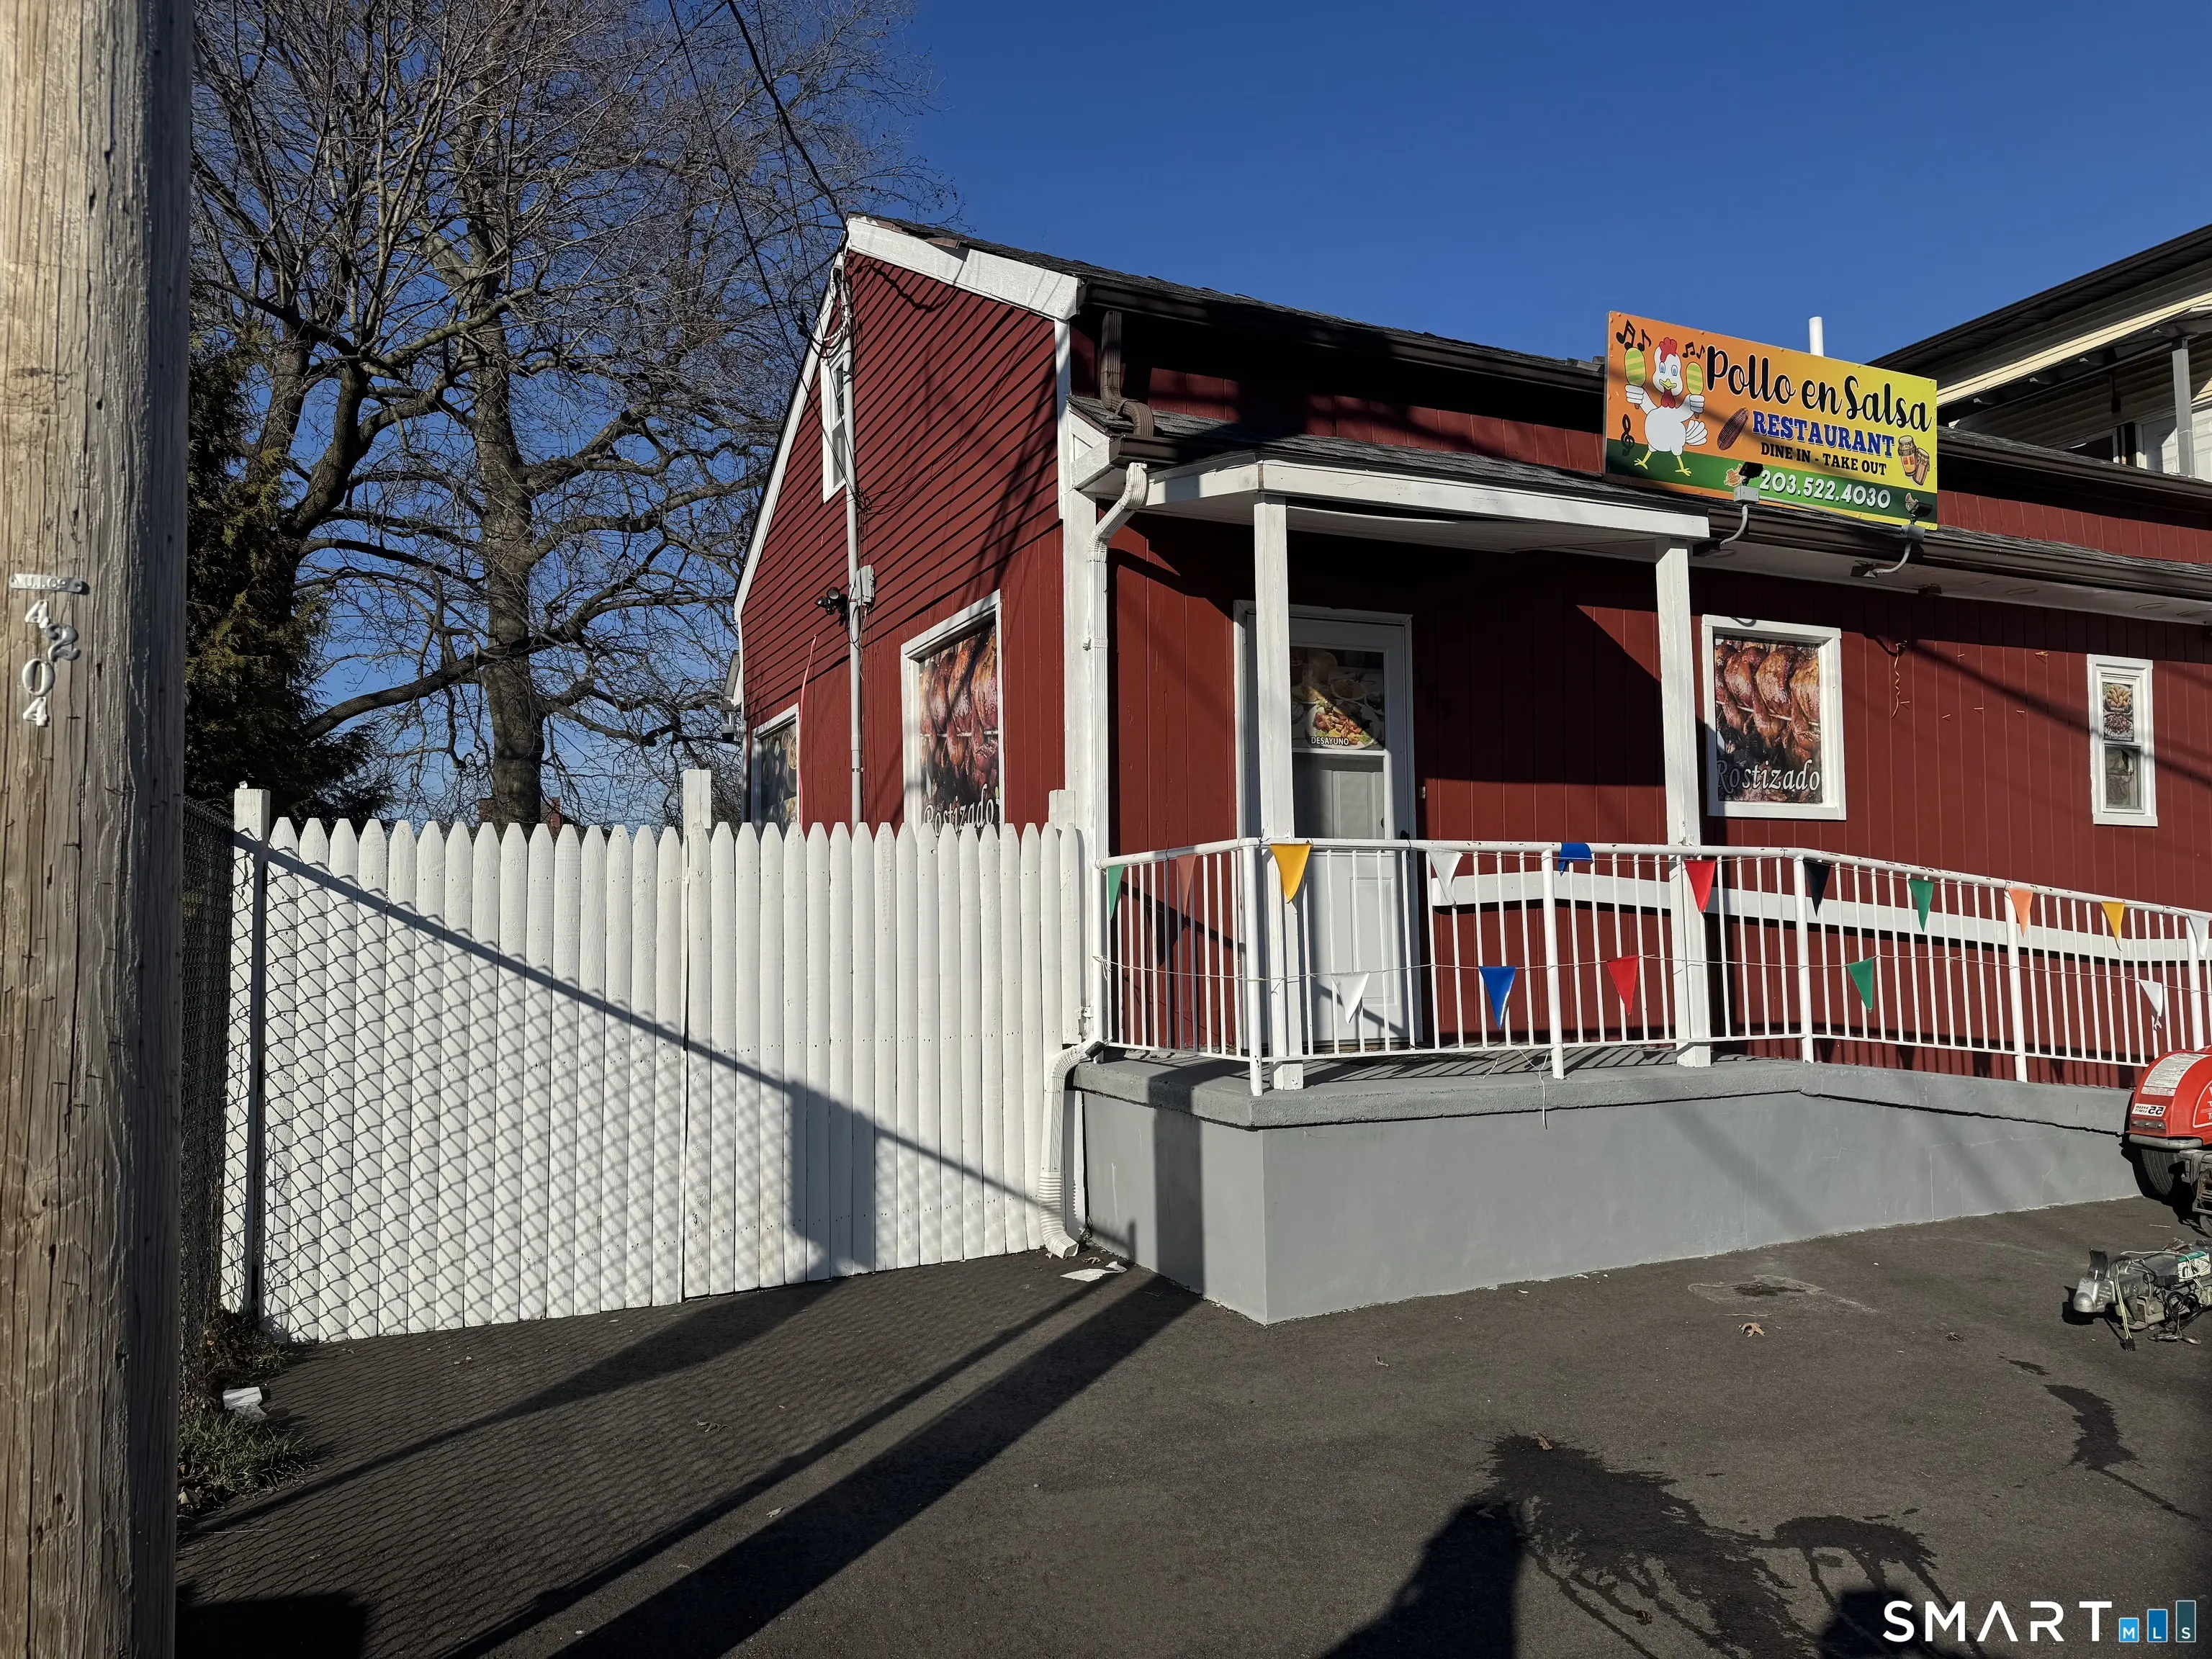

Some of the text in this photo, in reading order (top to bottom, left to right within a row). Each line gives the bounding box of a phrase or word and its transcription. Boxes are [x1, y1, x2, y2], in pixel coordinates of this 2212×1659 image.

[1707, 346, 1932, 432] Pollo en Salsa
[1753, 410, 1894, 458] RESTAURANT
[1761, 441, 1793, 459] DINE
[1797, 449, 1811, 462] IN
[1822, 453, 1858, 471] TAKE
[1861, 459, 1887, 475] OUT
[1759, 469, 1891, 508] 203.522.4030
[1311, 736, 1349, 746] DESAYUNO
[1717, 759, 1820, 794] Rostizado
